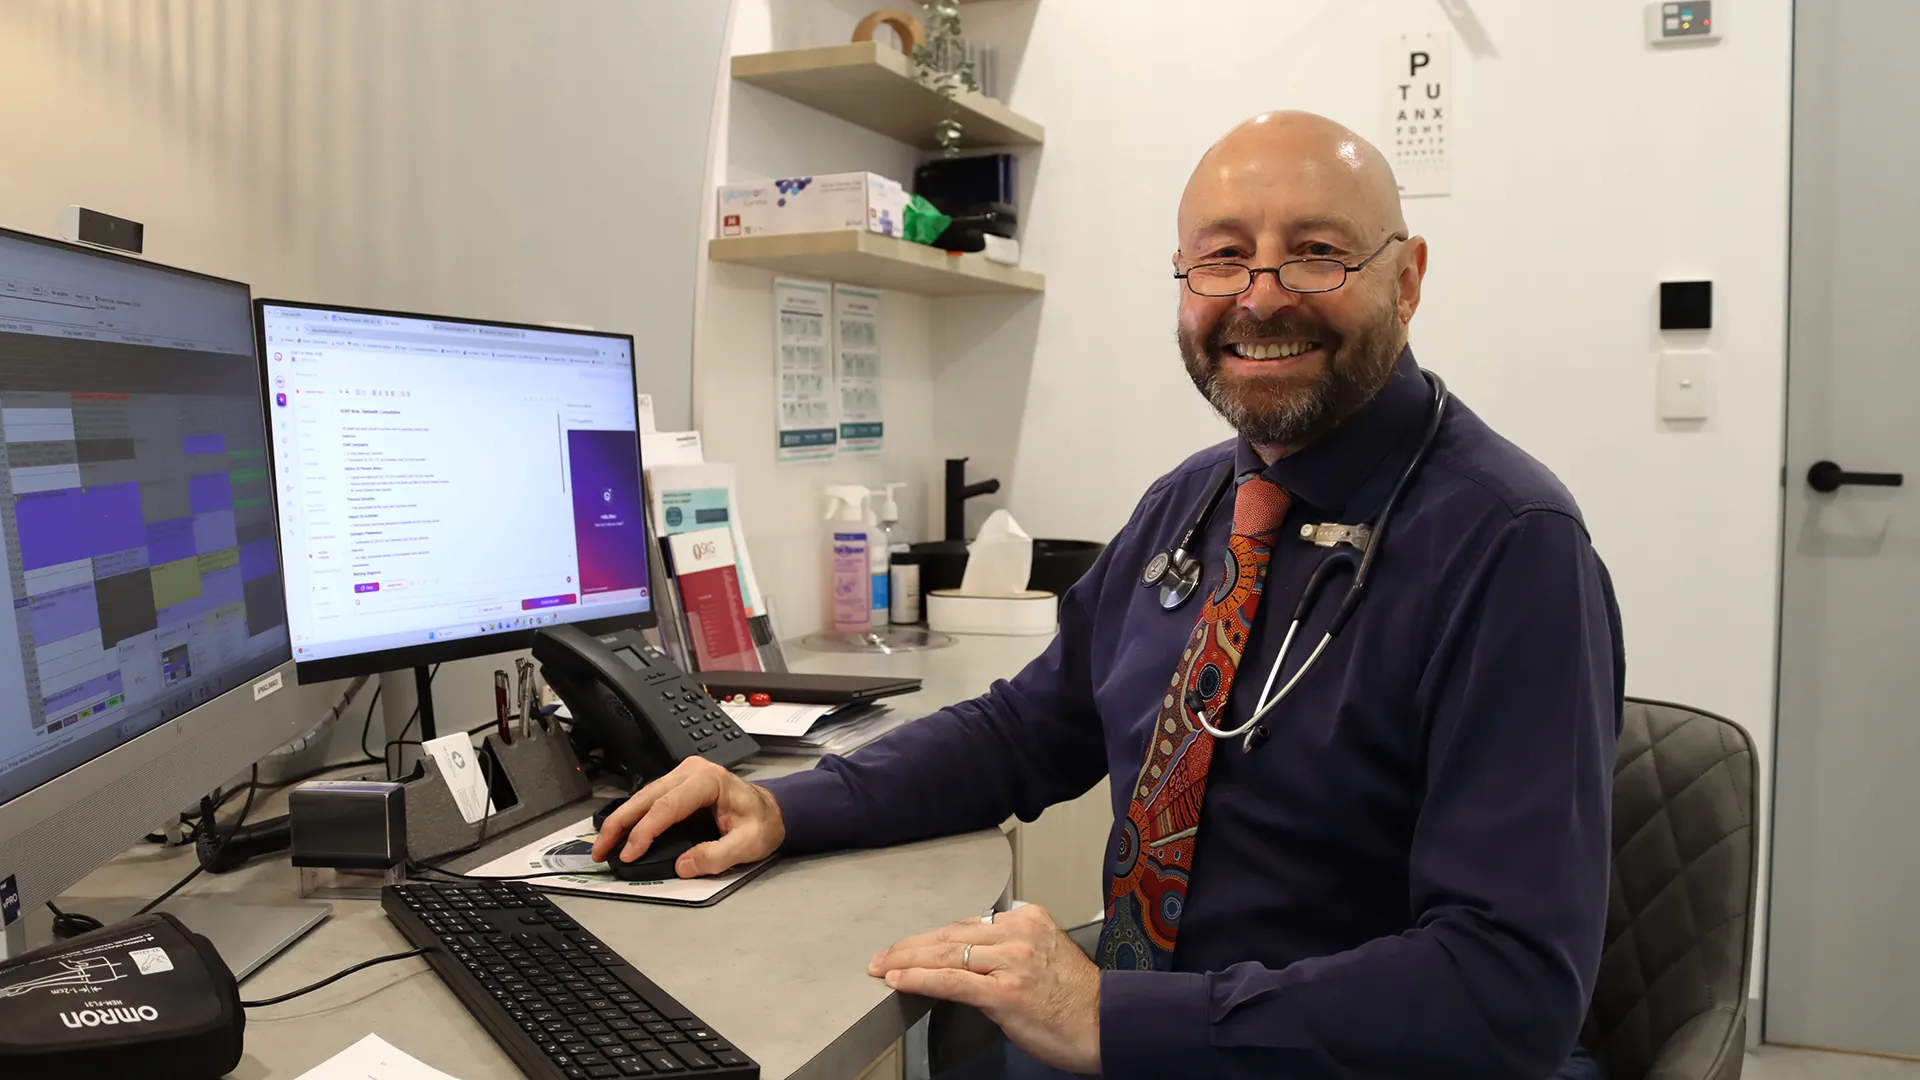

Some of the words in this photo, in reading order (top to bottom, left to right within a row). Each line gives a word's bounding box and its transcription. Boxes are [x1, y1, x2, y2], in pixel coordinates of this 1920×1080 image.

[1410, 52, 1430, 77] P
[1398, 84, 1411, 100] T
[1426, 83, 1441, 100] U
[60, 1006, 158, 1028] OMRON
